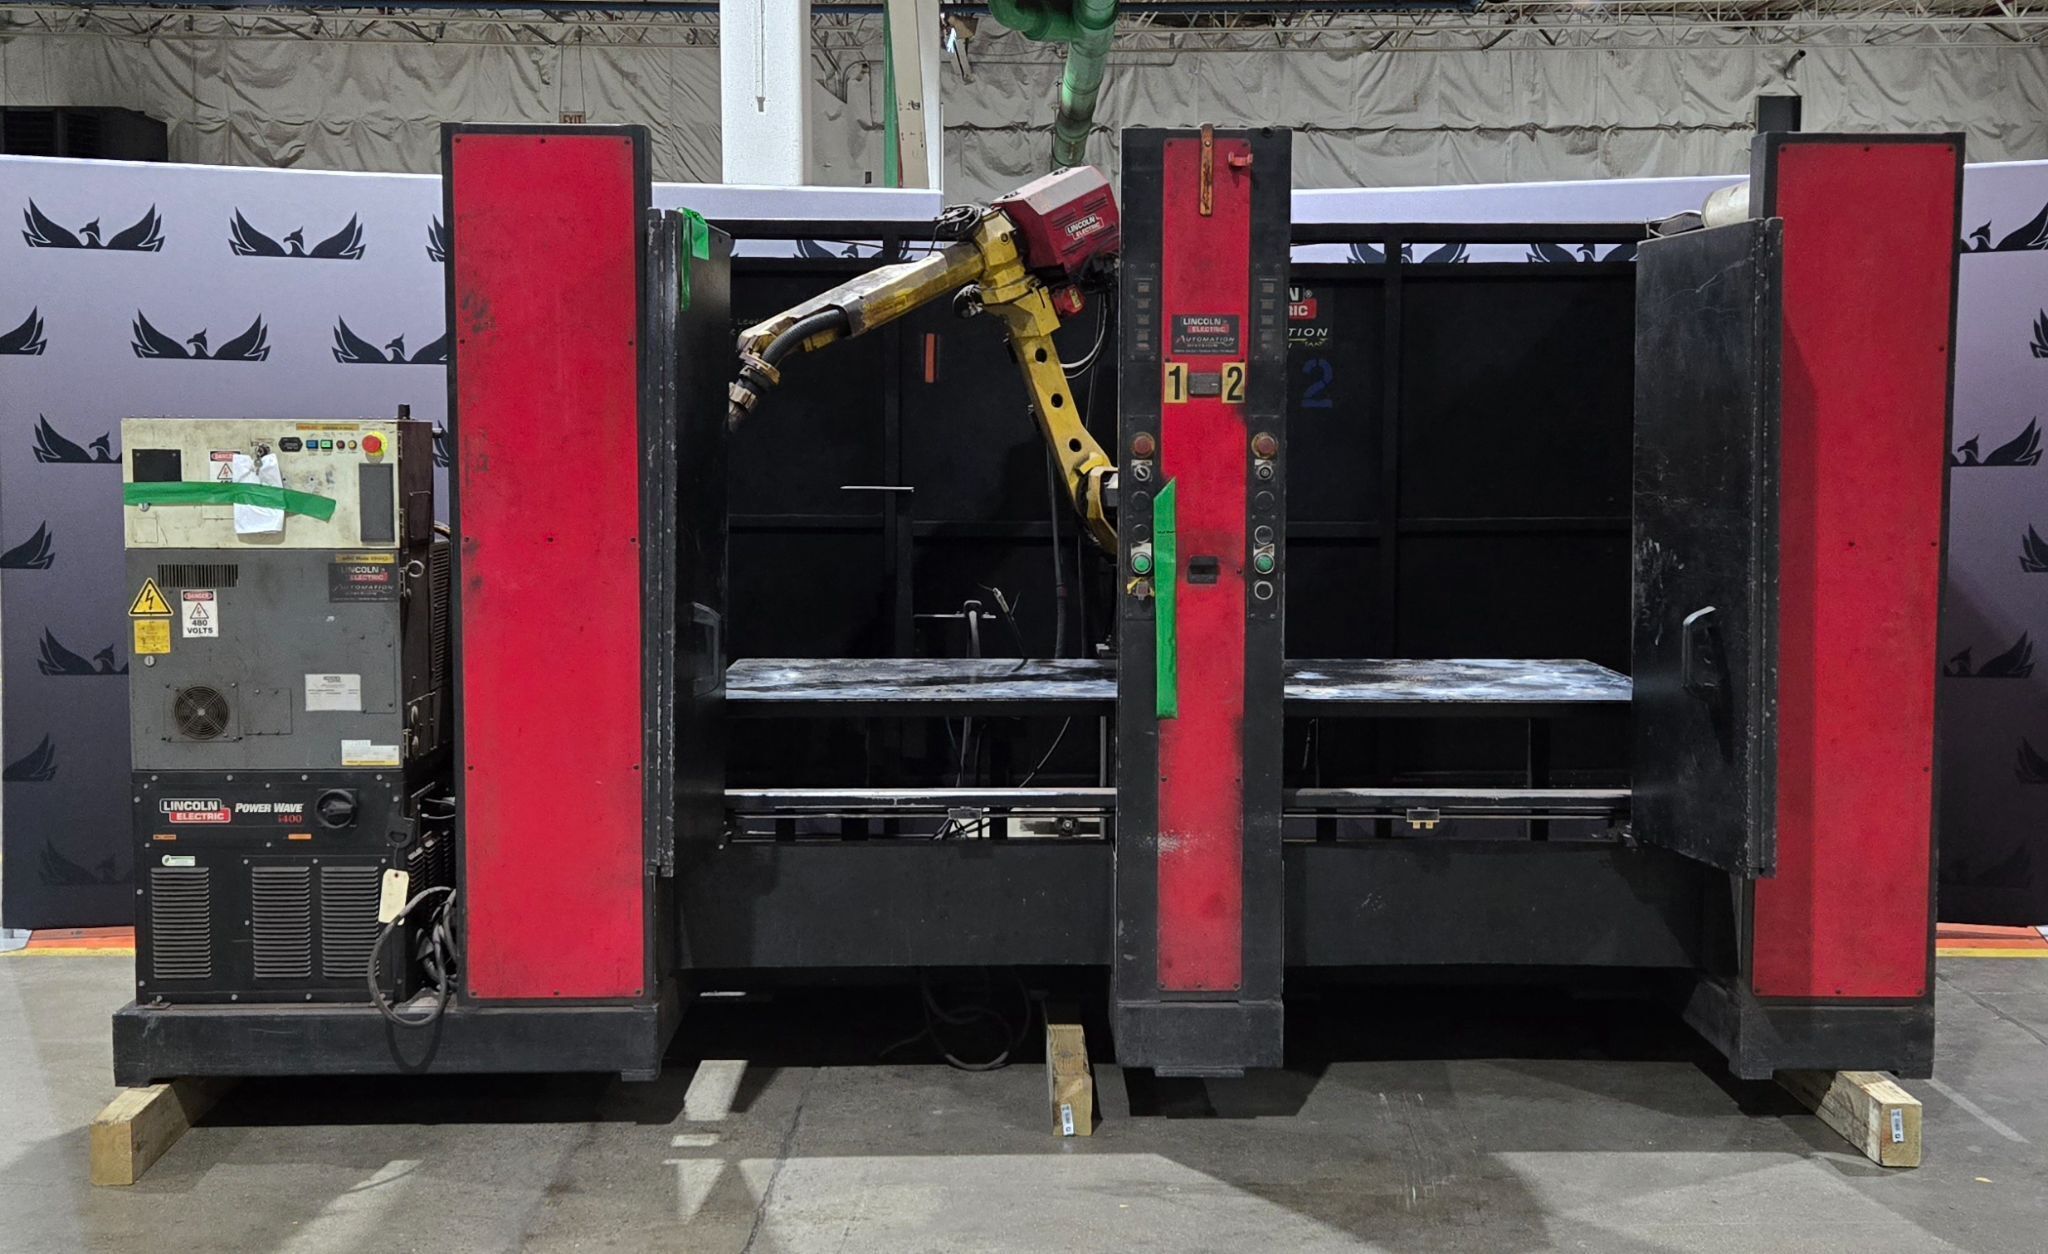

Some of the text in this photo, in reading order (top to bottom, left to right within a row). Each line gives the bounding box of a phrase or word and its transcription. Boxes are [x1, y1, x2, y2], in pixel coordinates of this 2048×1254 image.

[1067, 215, 1096, 233] LINCOLN
[1183, 317, 1221, 325] LINCOLN
[1168, 365, 1181, 400] 1
[1226, 365, 1244, 400] 2
[1302, 358, 1333, 408] 2
[163, 801, 218, 811] LINCOLN
[235, 803, 303, 813] POWER WAVE
[176, 812, 225, 820] ELECTRIC
